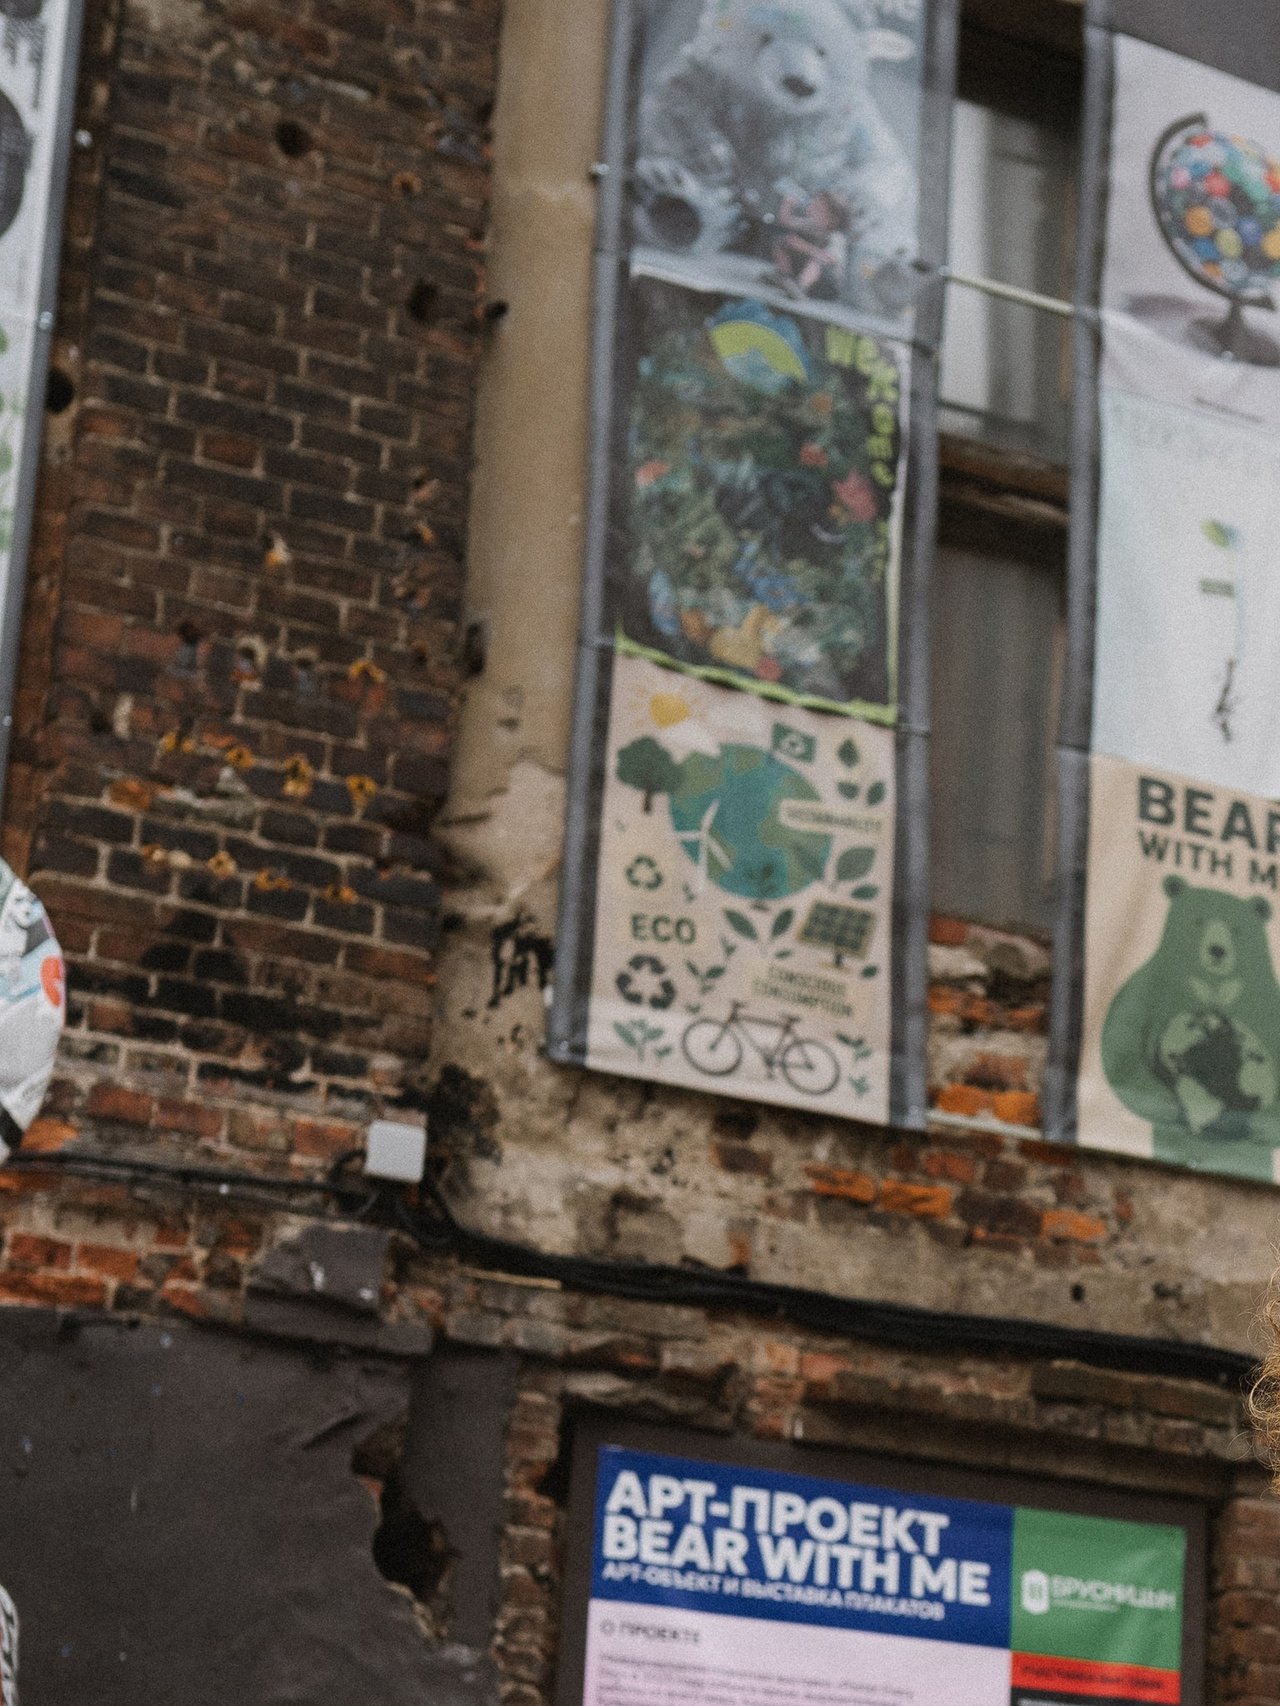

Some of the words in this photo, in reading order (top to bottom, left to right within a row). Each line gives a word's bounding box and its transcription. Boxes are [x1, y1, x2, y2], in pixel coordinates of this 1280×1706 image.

[1138, 828, 1233, 879] WITH
[630, 914, 697, 945] ECO
[605, 1470, 950, 1556] АРТ-ПРОЕКТ
[602, 1562, 720, 1594] АРТ-ОБЪЕКТ
[723, 1577, 739, 1595] И
[742, 1579, 843, 1608] ВЫСТАВКА
[603, 1514, 748, 1576] BEAR
[757, 1533, 901, 1595] WITH
[911, 1556, 991, 1607] ME
